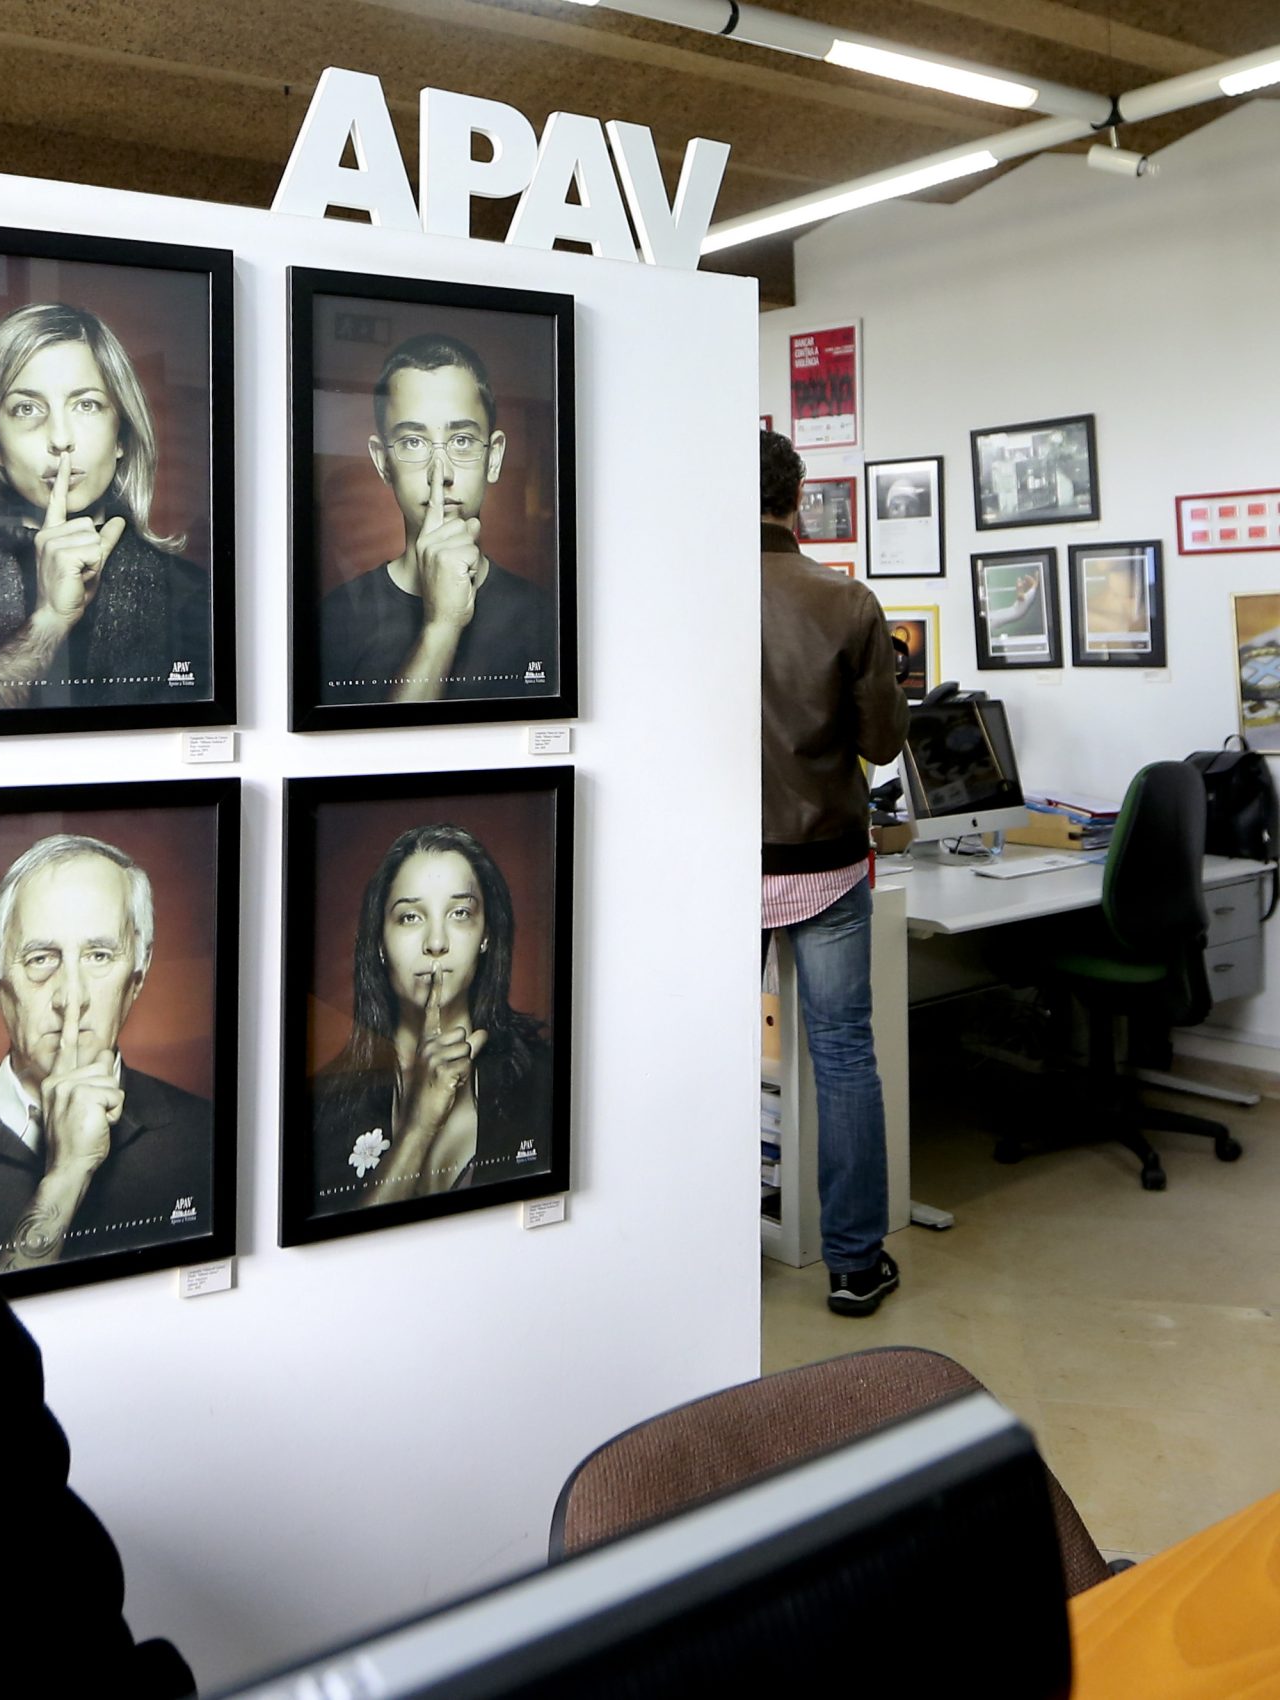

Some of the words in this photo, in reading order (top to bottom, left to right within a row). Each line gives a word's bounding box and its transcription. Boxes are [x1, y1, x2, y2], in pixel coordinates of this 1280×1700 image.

[270, 66, 732, 270] APAV
[172, 661, 191, 673] APAV
[527, 661, 542, 671] APAV
[519, 1138, 535, 1151] APAV
[174, 1197, 193, 1210] APAV
